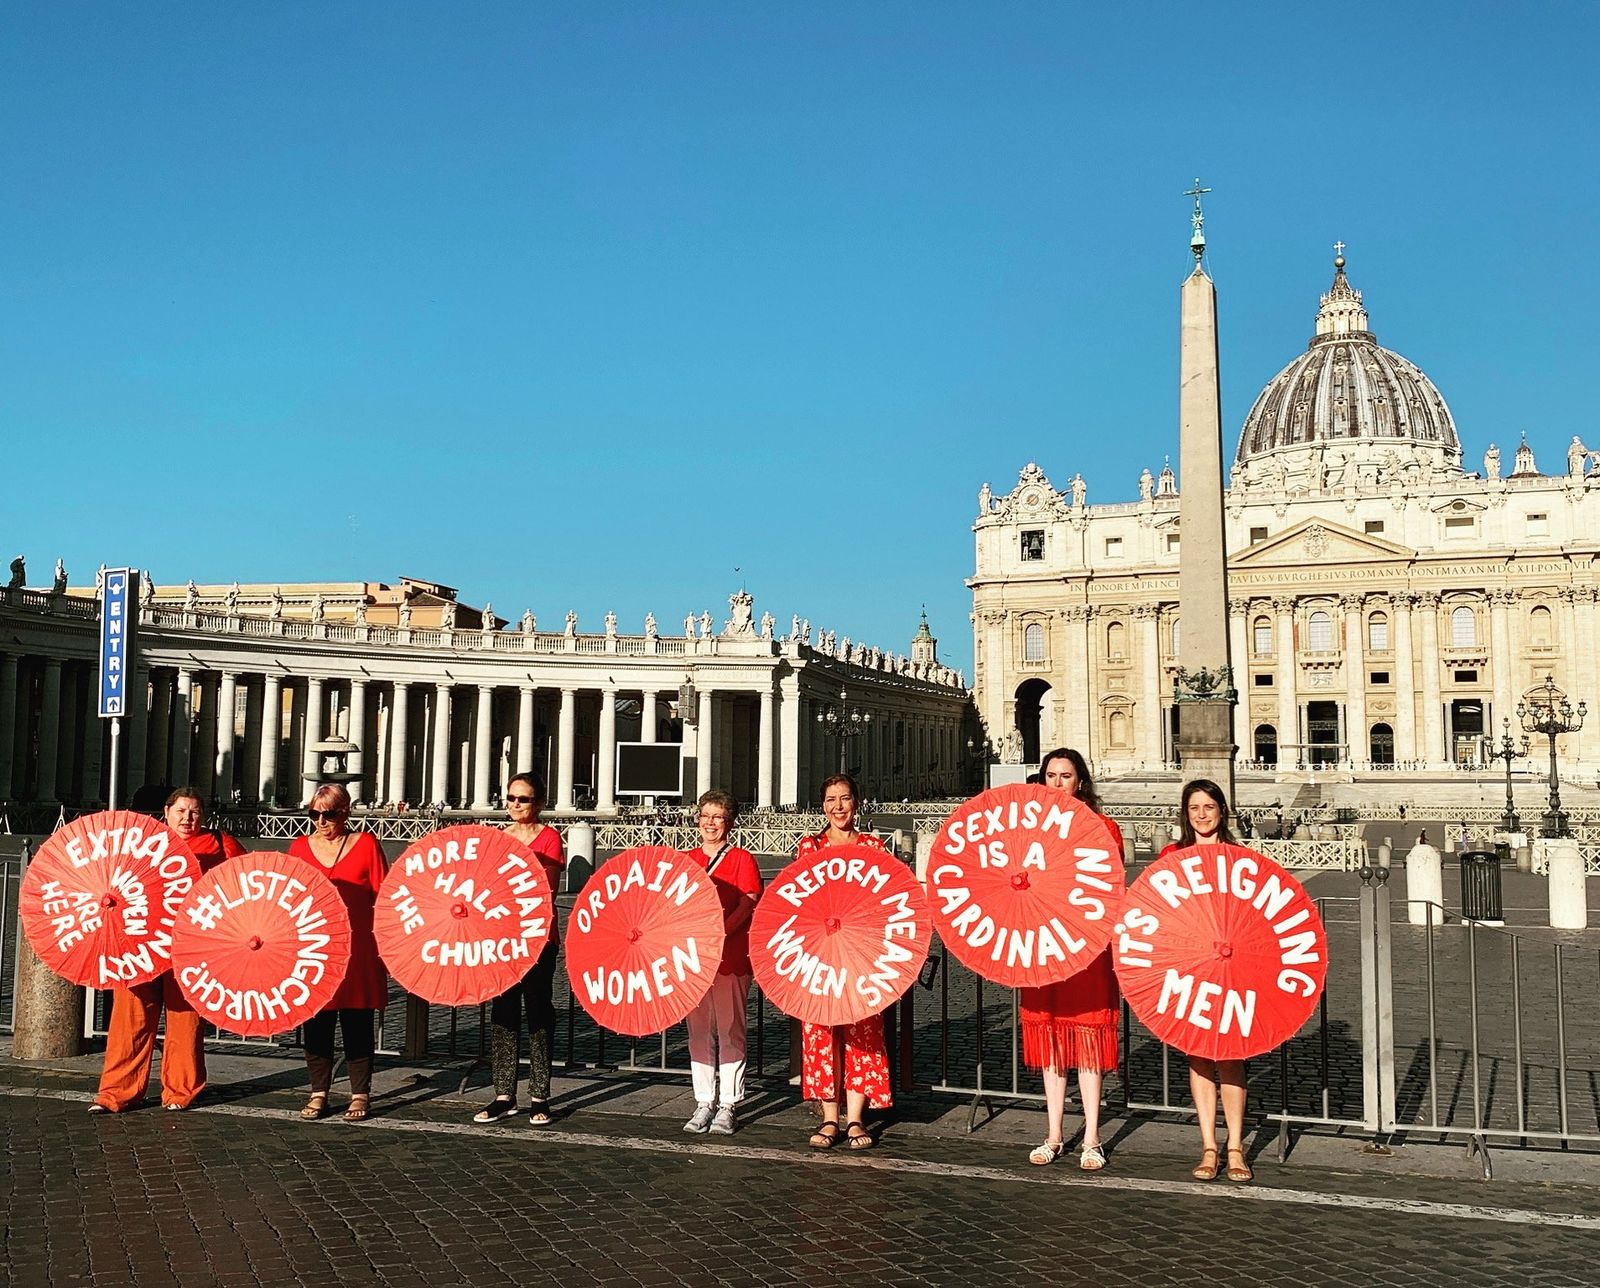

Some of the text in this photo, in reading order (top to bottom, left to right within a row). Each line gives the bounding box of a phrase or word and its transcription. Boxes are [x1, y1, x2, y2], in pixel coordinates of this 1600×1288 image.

[1070, 584, 1082, 592] IN
[1088, 582, 1140, 593] HONOREM
[1349, 568, 1408, 579] ROMANVS
[1573, 561, 1591, 569] VII
[108, 601, 121, 690] ENTRY
[945, 800, 1074, 855] SEXISM
[978, 841, 1046, 871] IS A
[40, 880, 84, 952] HERE
[68, 891, 102, 933] ARE
[111, 866, 149, 936] WOMEN
[390, 884, 425, 935] THE
[405, 838, 547, 938] MORE THAN
[434, 872, 511, 921] HALF
[577, 859, 699, 933] ORDAIN
[933, 847, 1113, 968] CARDINAL SIN
[421, 937, 529, 967] CHURCH
[766, 914, 847, 999] WOMEN
[776, 858, 916, 1007] REFORM MEANS
[1114, 854, 1320, 998] IT'S REIGNING
[583, 937, 701, 1005] WOMEN
[1156, 968, 1256, 1038] MEN
